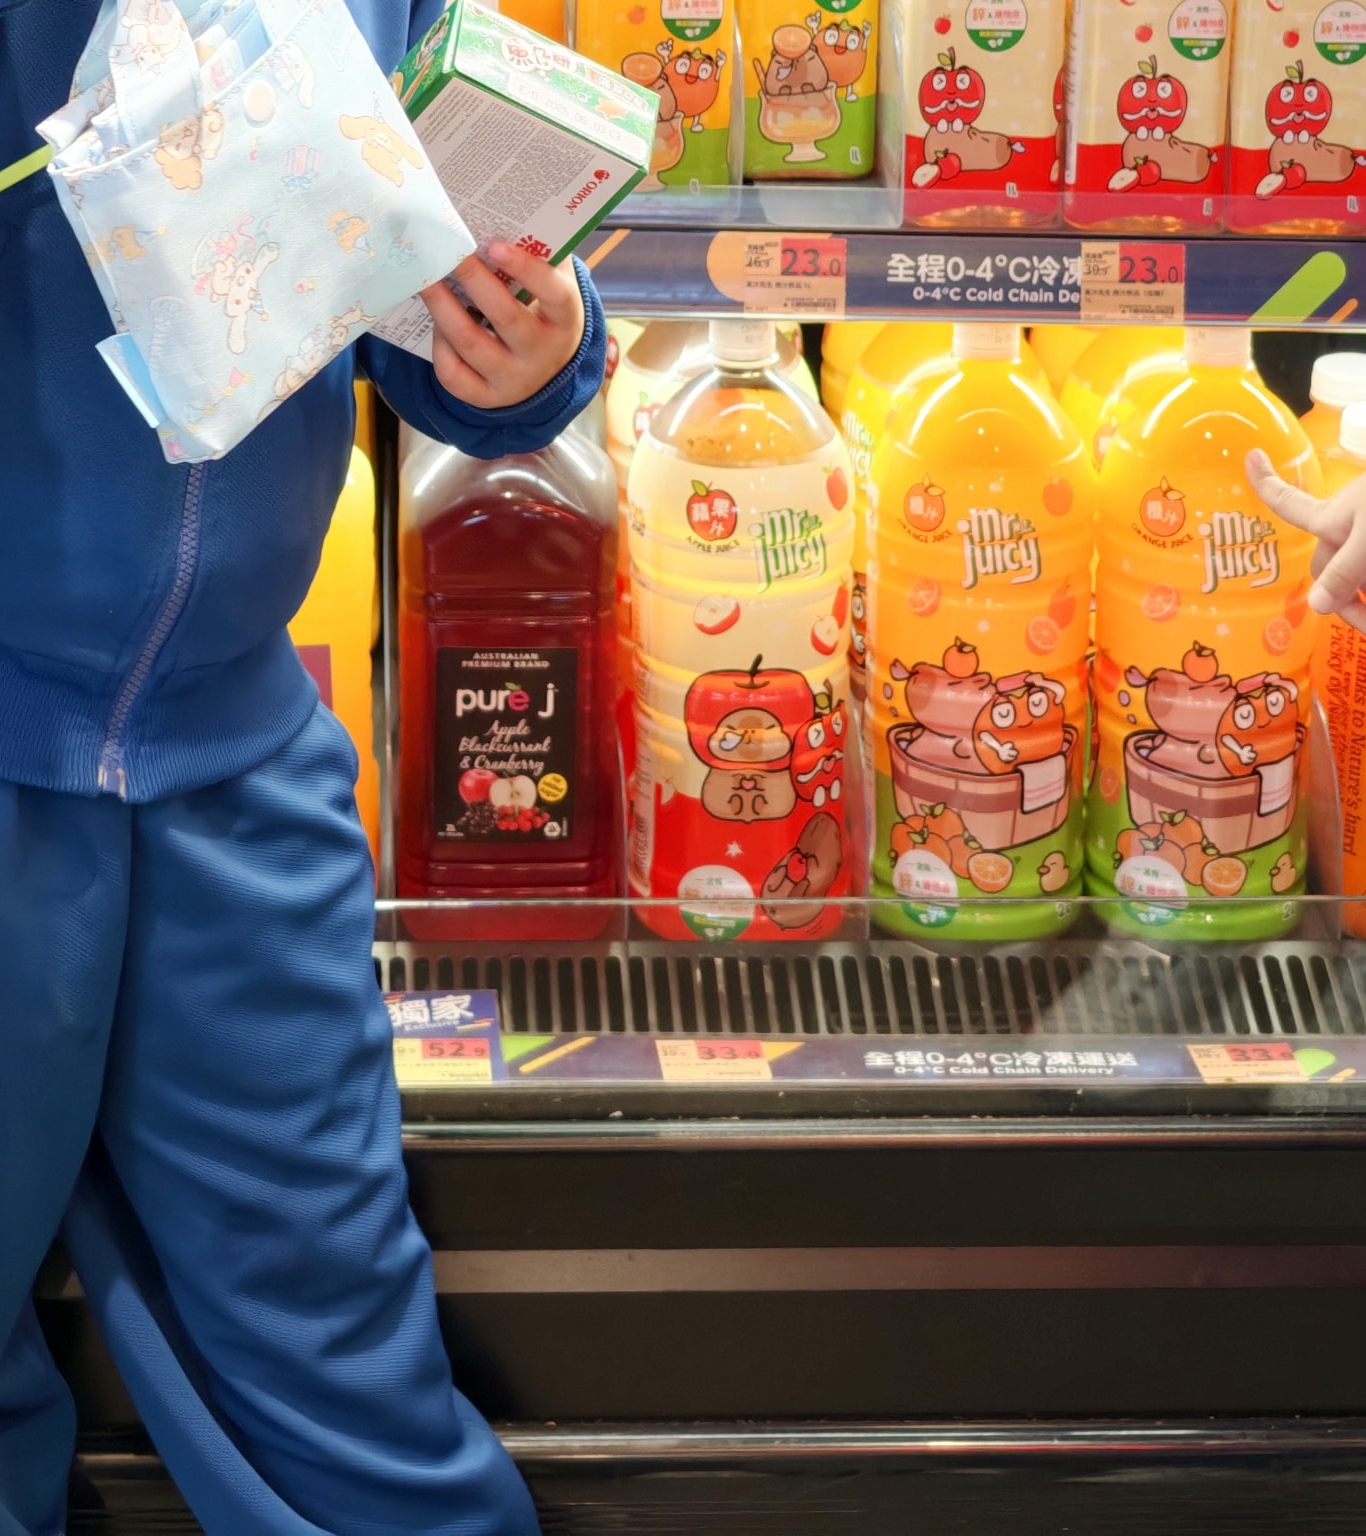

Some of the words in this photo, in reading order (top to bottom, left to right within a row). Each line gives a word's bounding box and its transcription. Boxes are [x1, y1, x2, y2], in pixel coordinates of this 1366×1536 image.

[564, 180, 599, 216] ORION
[781, 248, 843, 278] 23.0
[1120, 255, 1179, 284] 23.0
[913, 286, 962, 303] 0-4°C
[966, 287, 1004, 303] Cold
[1008, 287, 1054, 304] Chain
[484, 720, 531, 741] Apple
[1354, 711, 1365, 727] to
[473, 754, 544, 775] Cranberry
[1349, 729, 1366, 811] Nature's
[1342, 815, 1359, 856] hard
